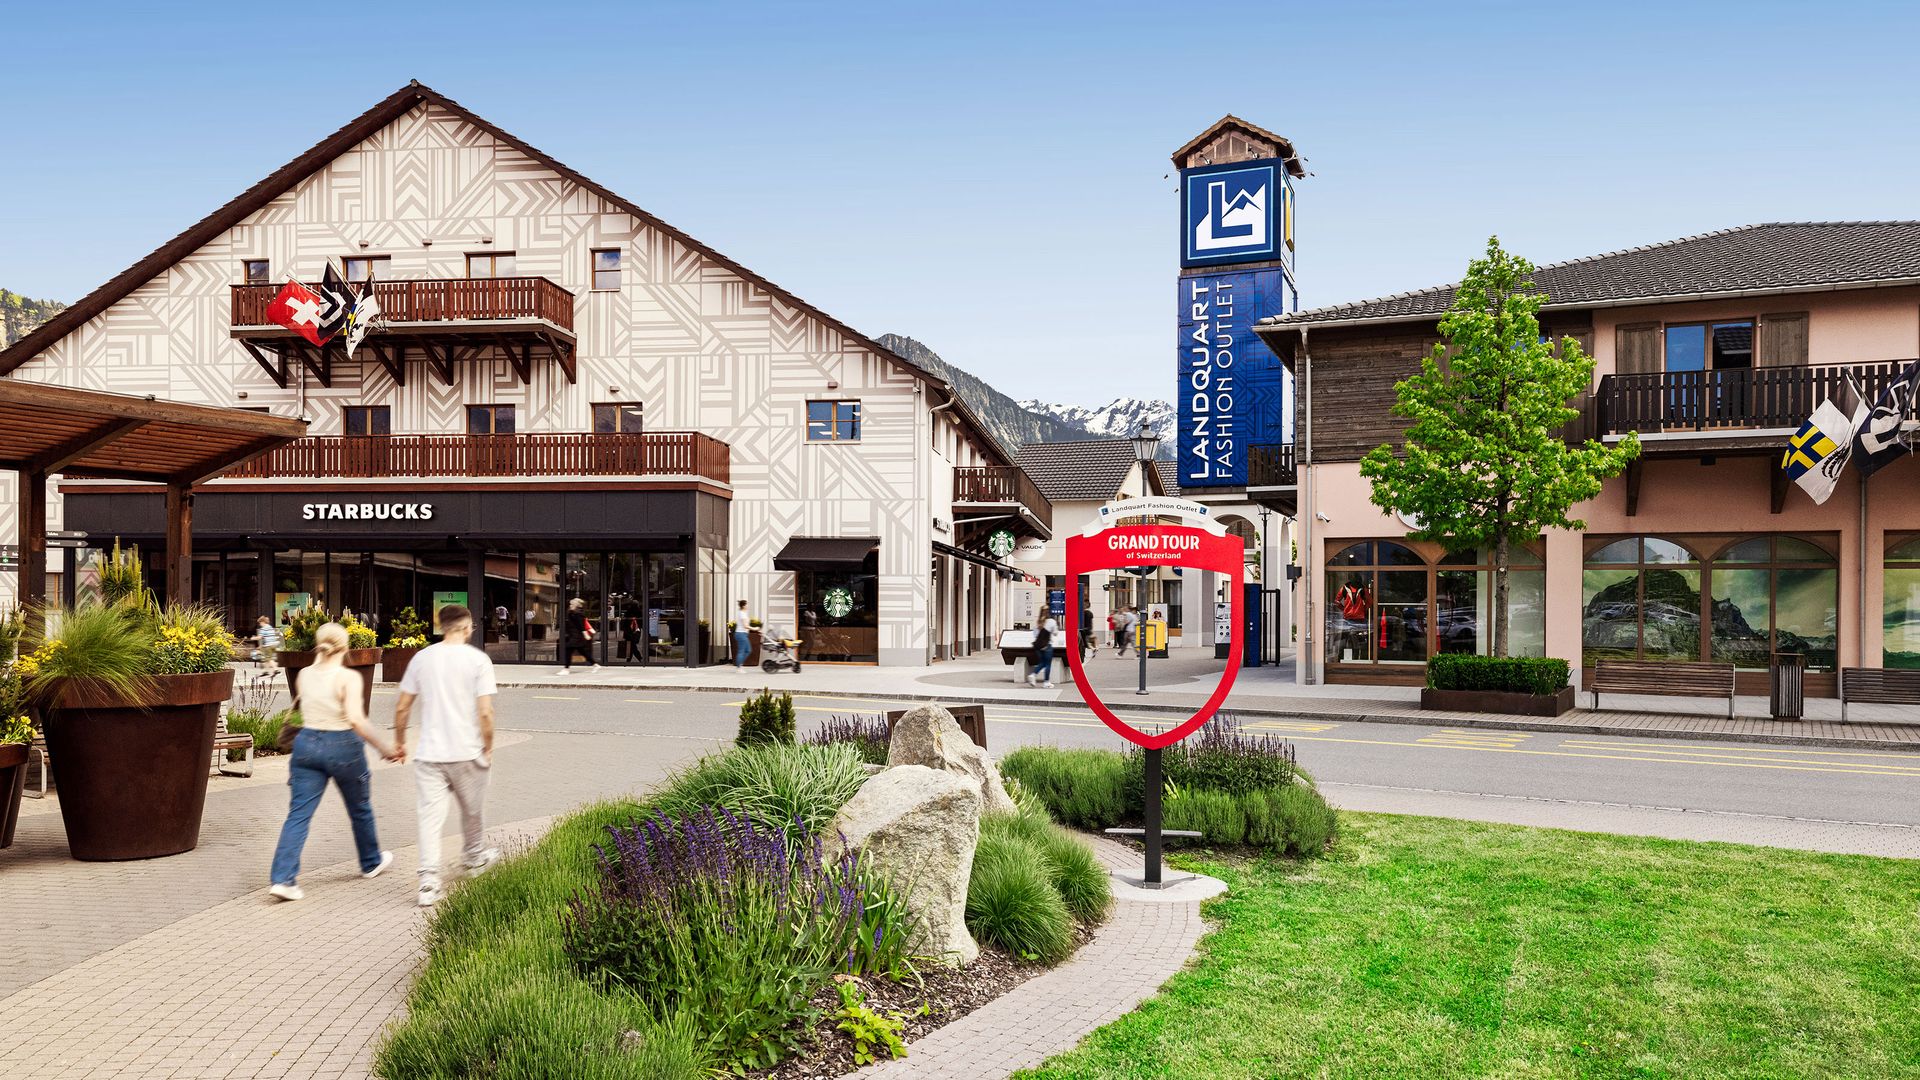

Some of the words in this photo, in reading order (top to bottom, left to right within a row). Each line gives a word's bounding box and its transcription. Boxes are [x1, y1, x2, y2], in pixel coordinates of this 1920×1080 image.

[1216, 281, 1233, 369] OUTLET
[1191, 281, 1211, 479] LANDQUART
[1216, 377, 1233, 478] FASHION
[302, 503, 433, 520] STARBUCKS
[1111, 503, 1146, 513] Landquart
[1176, 504, 1198, 513] Outlet
[1108, 534, 1159, 550] GRAND
[1161, 534, 1200, 550] TOUR
